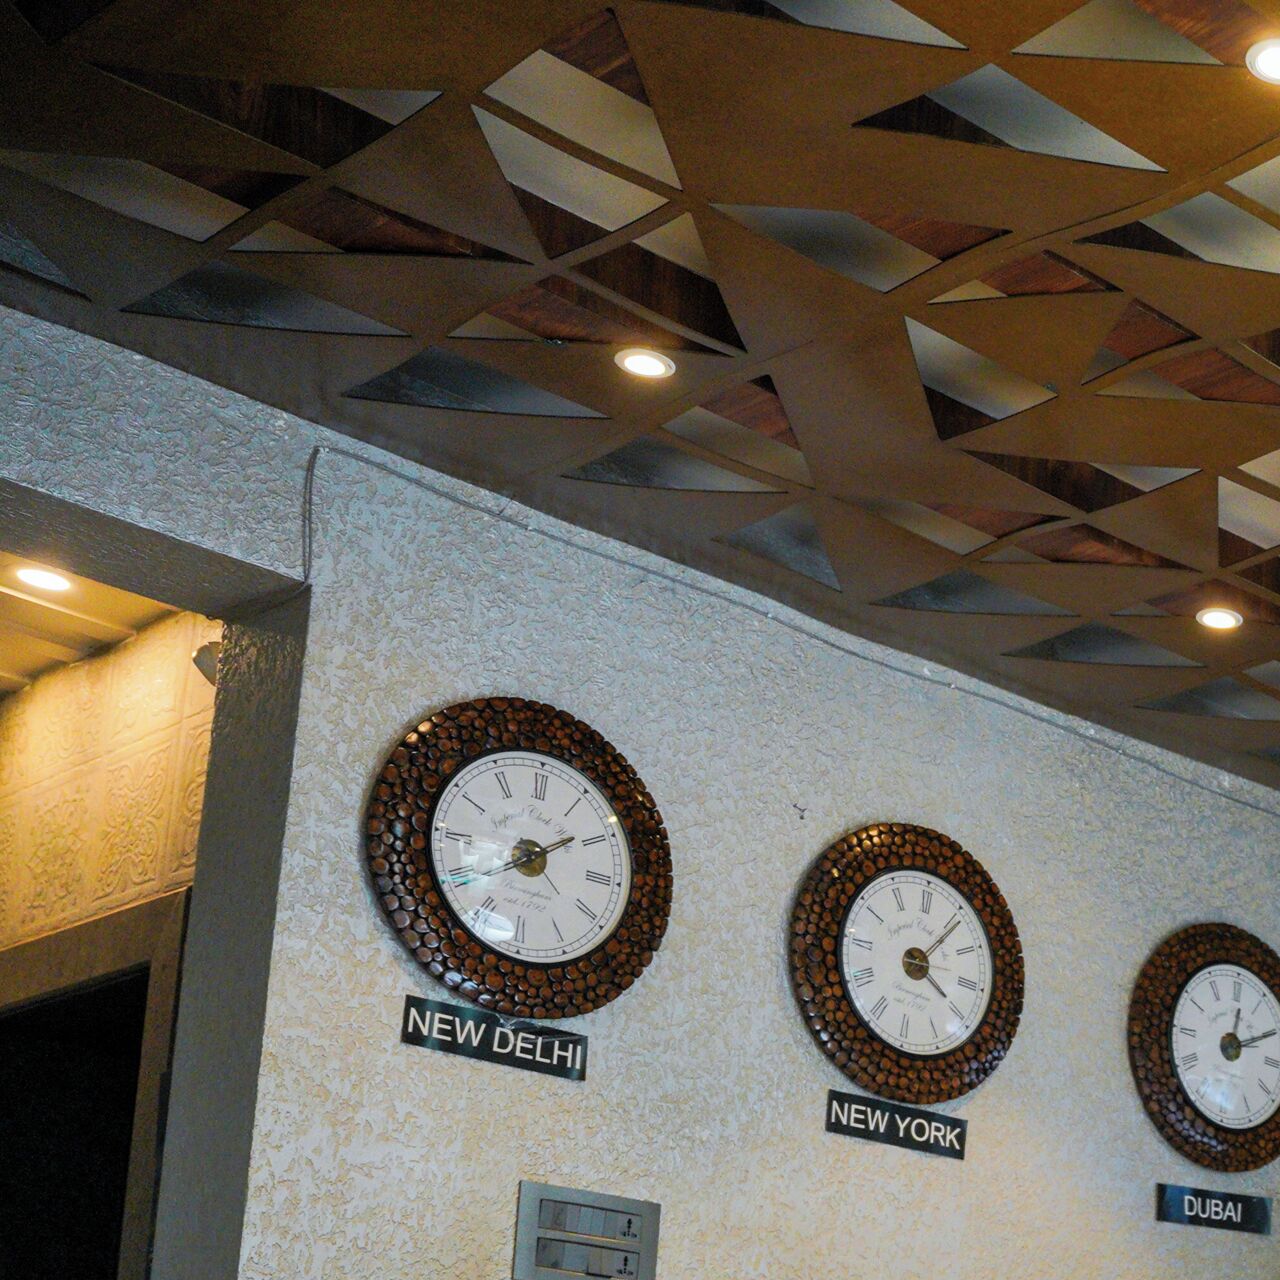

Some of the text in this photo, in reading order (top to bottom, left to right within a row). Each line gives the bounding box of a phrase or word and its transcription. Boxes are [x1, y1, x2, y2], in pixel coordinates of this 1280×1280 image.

[407, 1006, 582, 1070] NEW DELHI
[831, 1100, 961, 1150] NEW YORK
[1183, 1195, 1242, 1223] DUBAI
